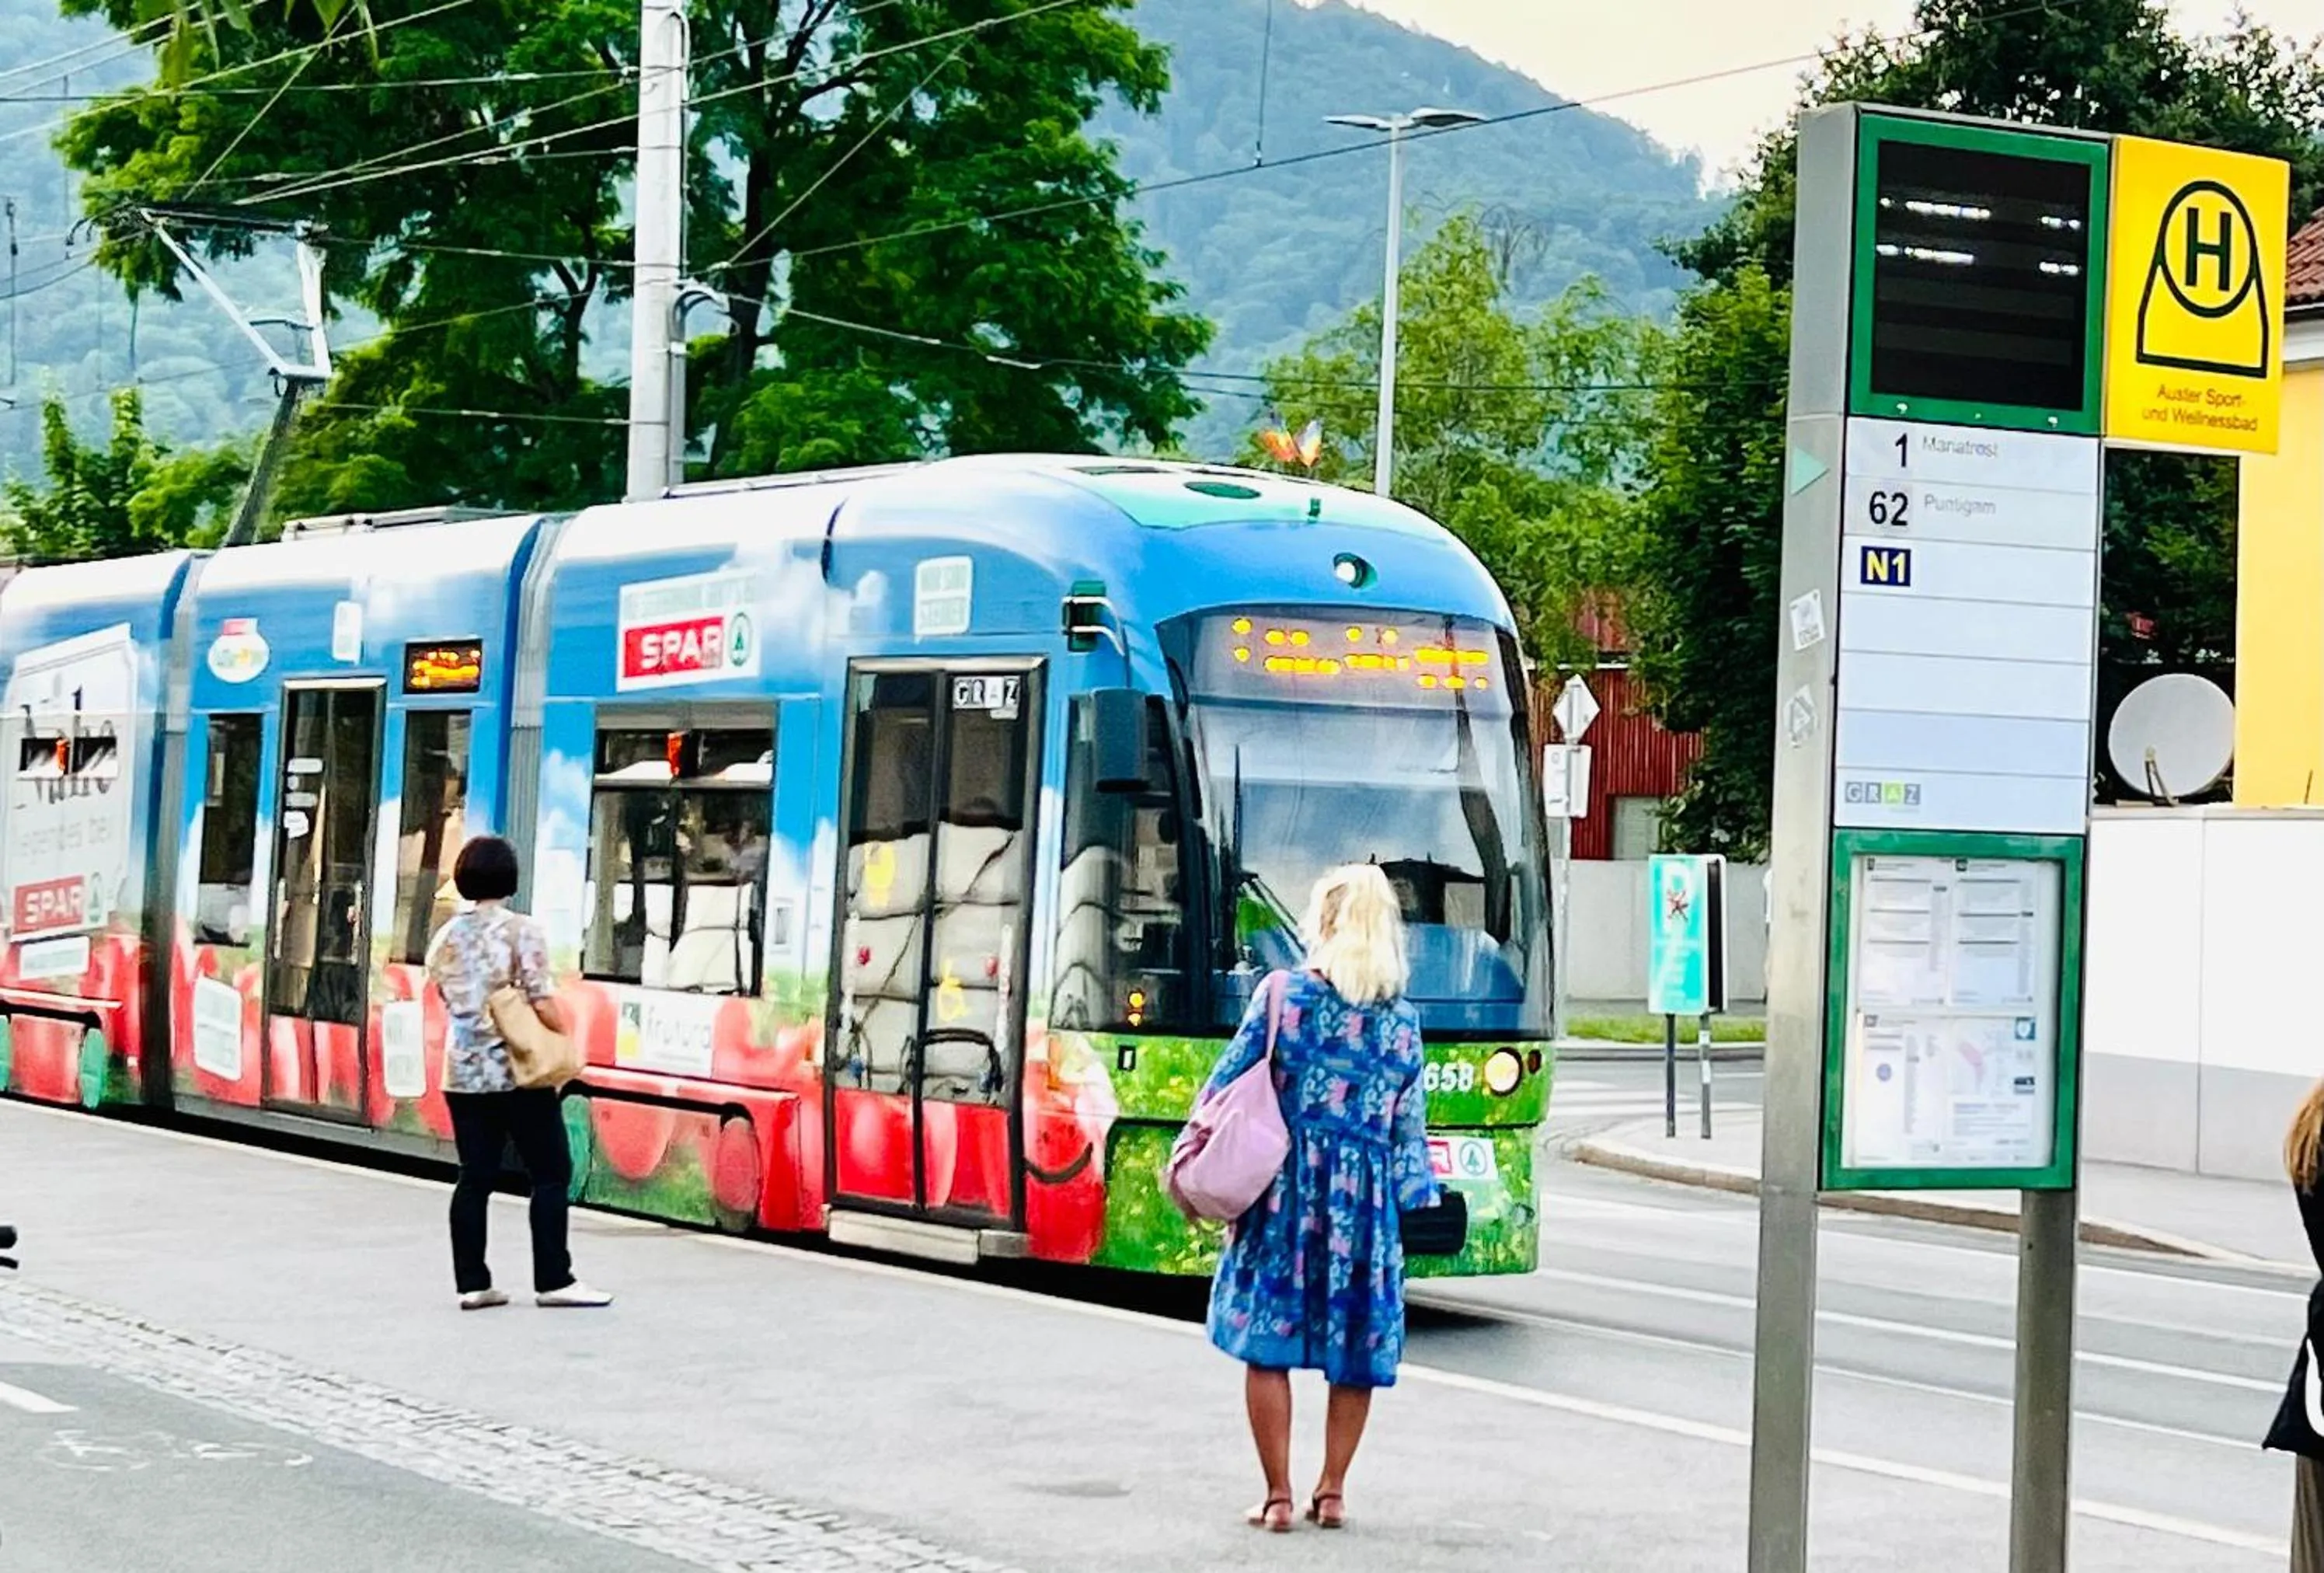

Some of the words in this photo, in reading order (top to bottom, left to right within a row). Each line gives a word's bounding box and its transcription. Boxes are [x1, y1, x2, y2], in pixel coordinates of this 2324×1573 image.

[2185, 208, 2232, 291] H
[1894, 433, 1908, 468] 1
[1869, 490, 1908, 526] 62
[1865, 549, 1907, 584] N1
[639, 625, 724, 671] SPAR
[1845, 782, 1921, 805] GRAZ
[24, 884, 85, 924] SPAR
[1423, 1062, 1474, 1091] 658
